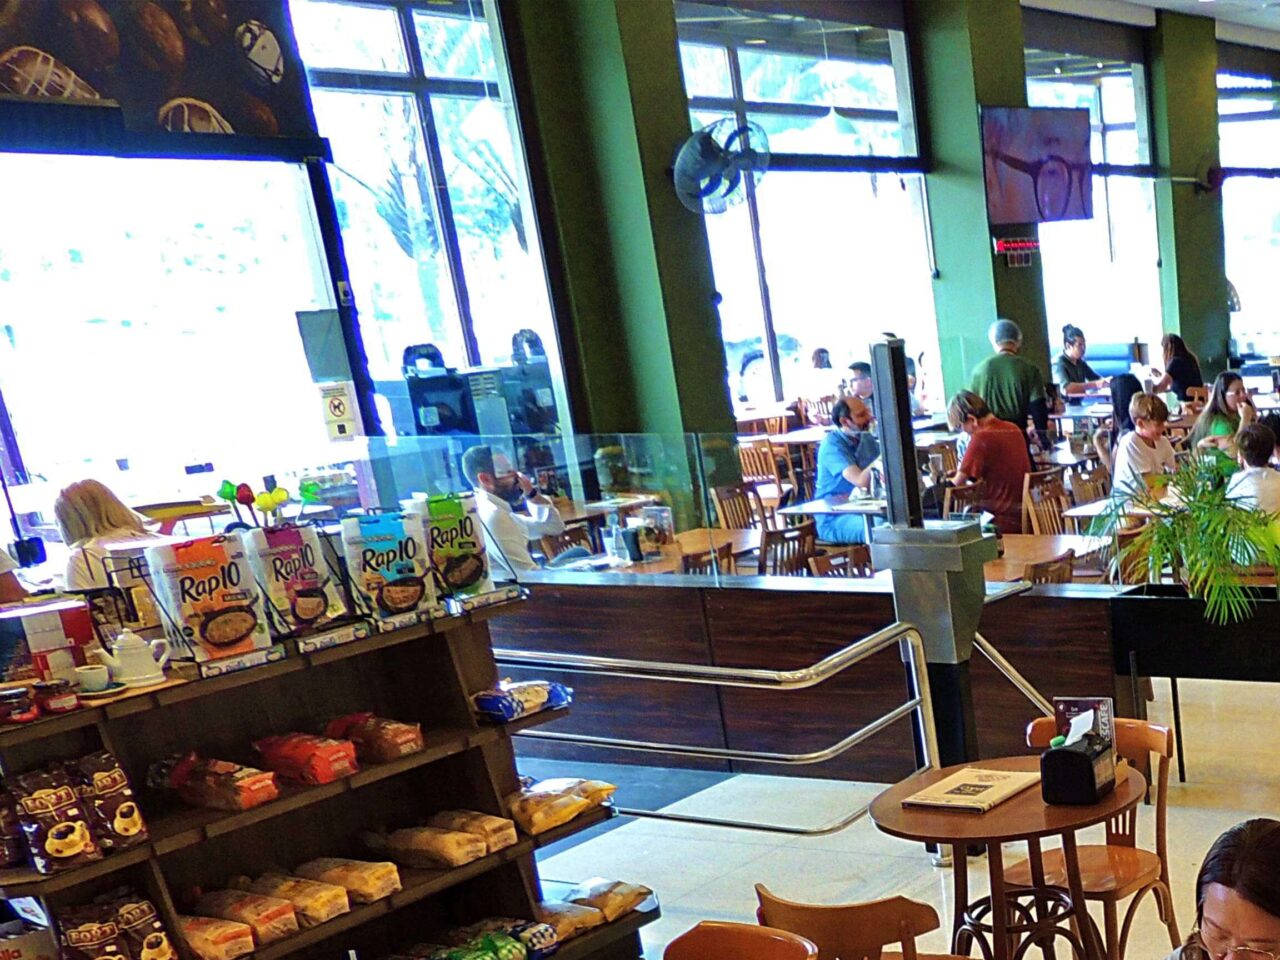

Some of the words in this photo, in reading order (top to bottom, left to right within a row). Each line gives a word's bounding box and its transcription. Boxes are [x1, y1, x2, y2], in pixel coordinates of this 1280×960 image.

[430, 516, 475, 550] Rap10
[272, 543, 315, 582] Rap10
[362, 537, 417, 573] Rap10
[180, 561, 241, 604] Rap10
